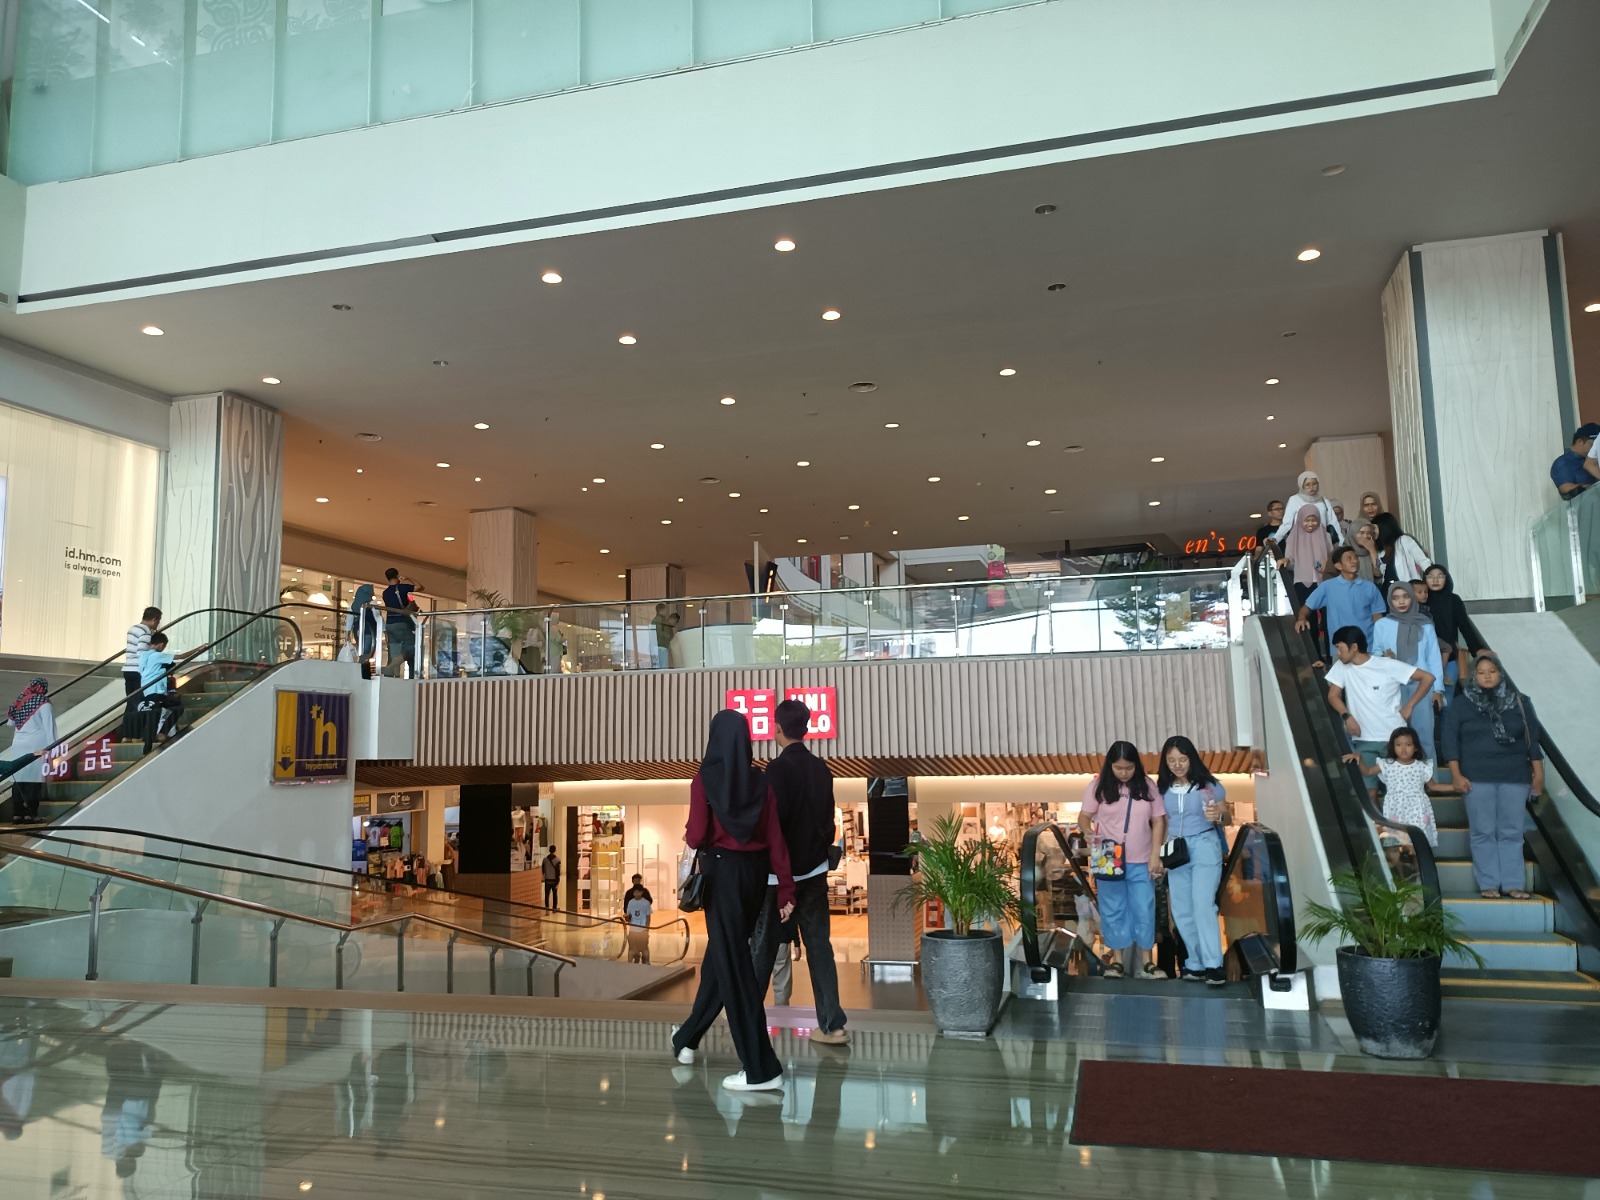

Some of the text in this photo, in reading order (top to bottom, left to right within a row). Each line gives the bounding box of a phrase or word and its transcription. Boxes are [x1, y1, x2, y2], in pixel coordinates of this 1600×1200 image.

[1185, 531, 1226, 554] en's
[65, 546, 122, 567] id.hm.com
[65, 561, 121, 578] is always open
[275, 634, 292, 651] GF
[281, 745, 292, 755] LG
[305, 762, 338, 772] hypermart
